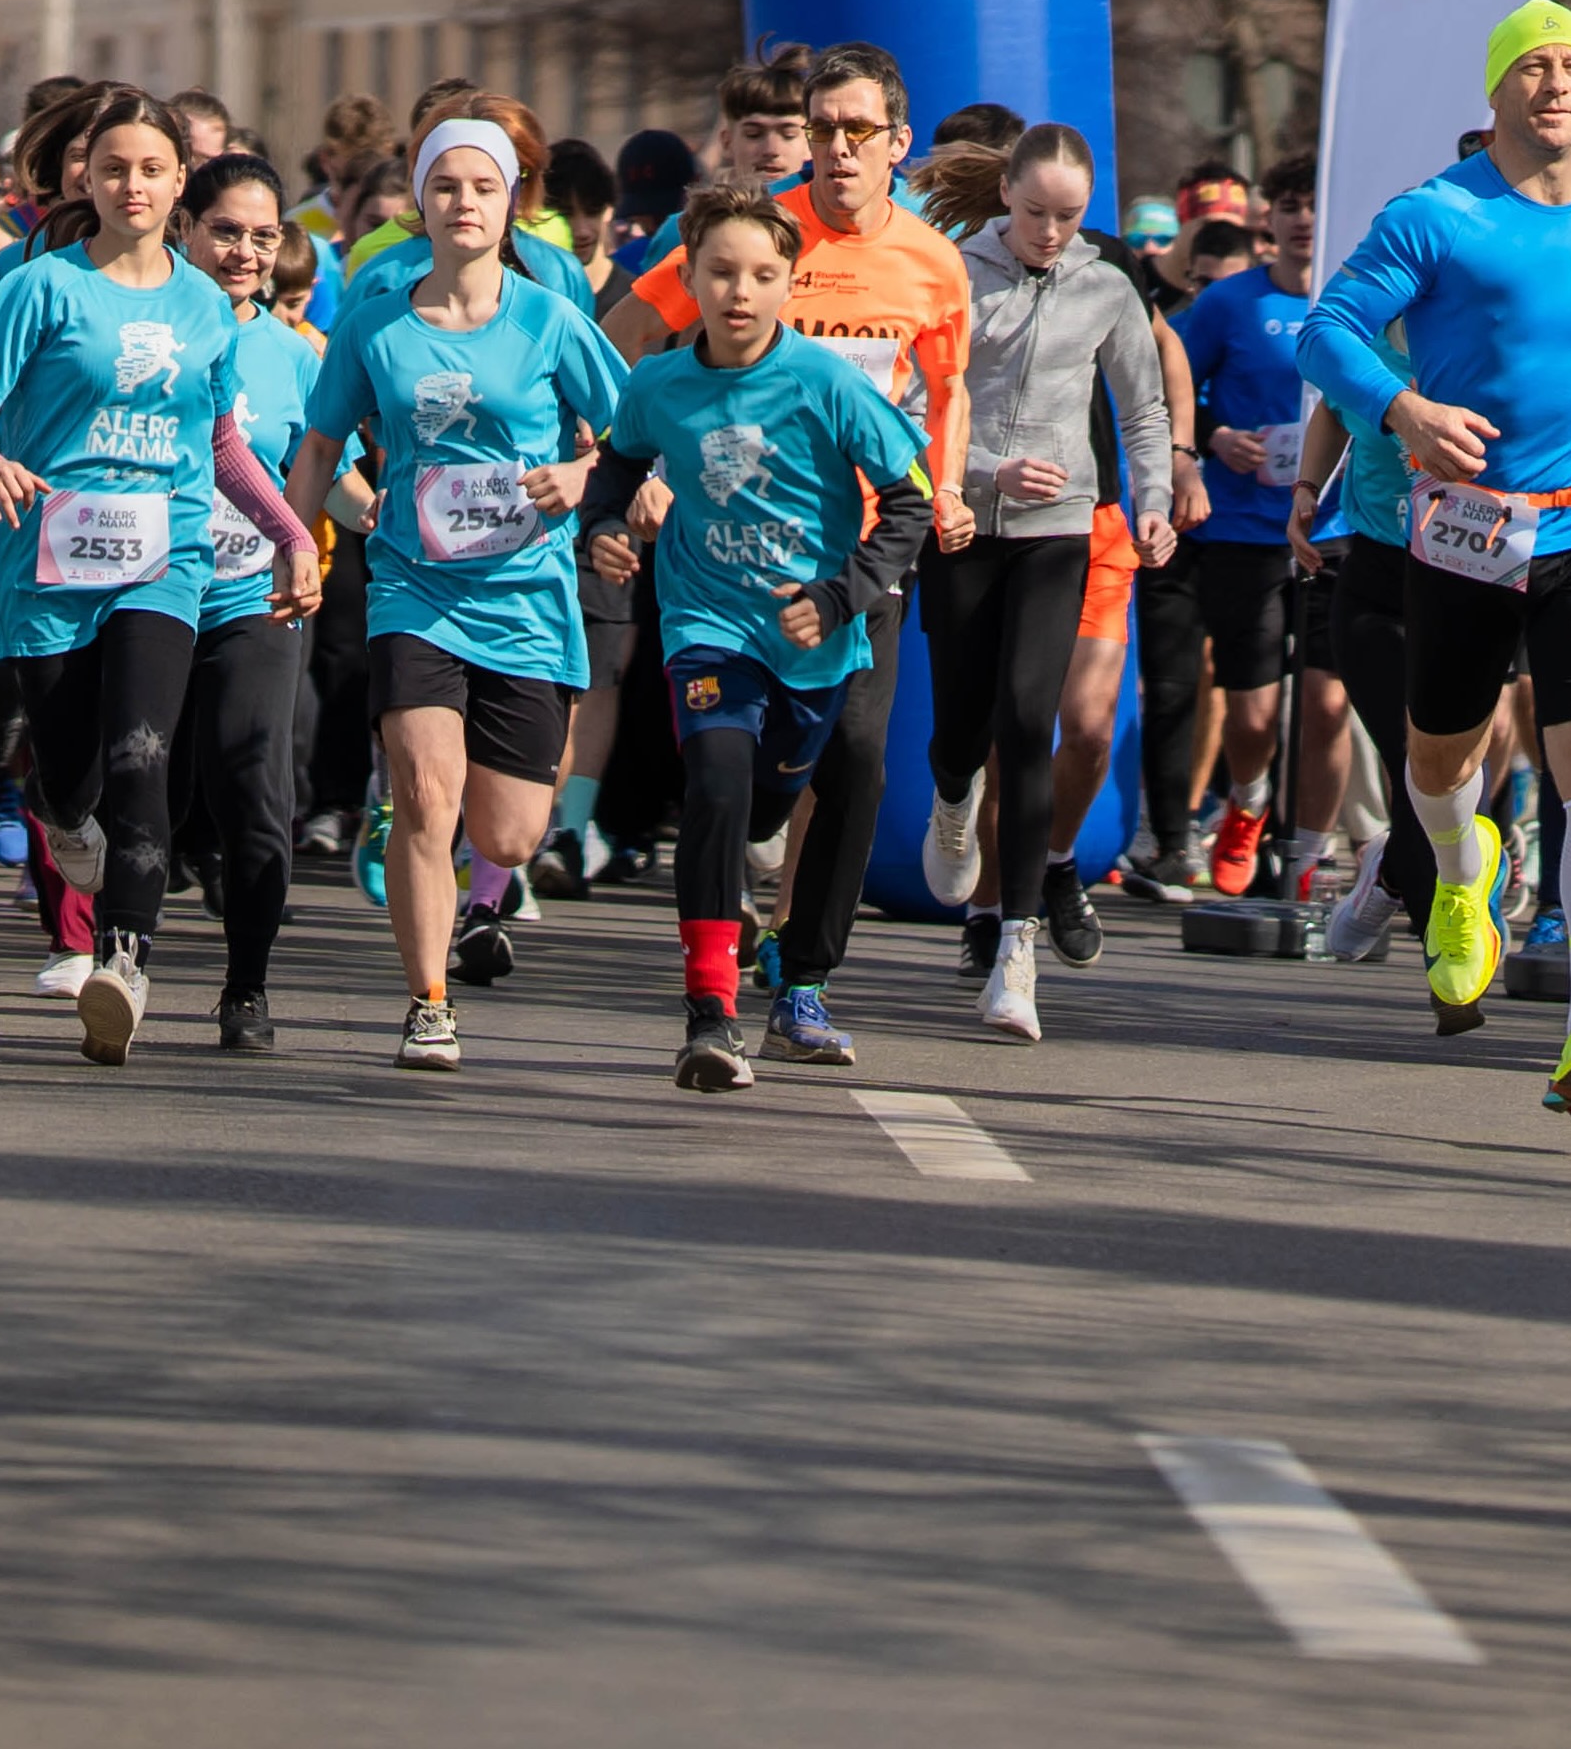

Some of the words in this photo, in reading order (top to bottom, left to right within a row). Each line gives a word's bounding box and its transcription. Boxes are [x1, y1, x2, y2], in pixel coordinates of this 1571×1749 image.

[813, 271, 856, 280] Stunden
[813, 281, 837, 290] Lauf
[89, 409, 180, 439] ALERG
[87, 431, 179, 463] MAMA
[470, 477, 510, 490] ALERG
[472, 486, 511, 498] MAMA
[98, 509, 137, 520] ALERG
[98, 519, 137, 529] MAMA
[446, 505, 525, 533] 2534
[211, 528, 260, 557] 789
[705, 521, 805, 548] ALERG
[1431, 520, 1508, 559] 2707
[69, 536, 144, 563] 2533
